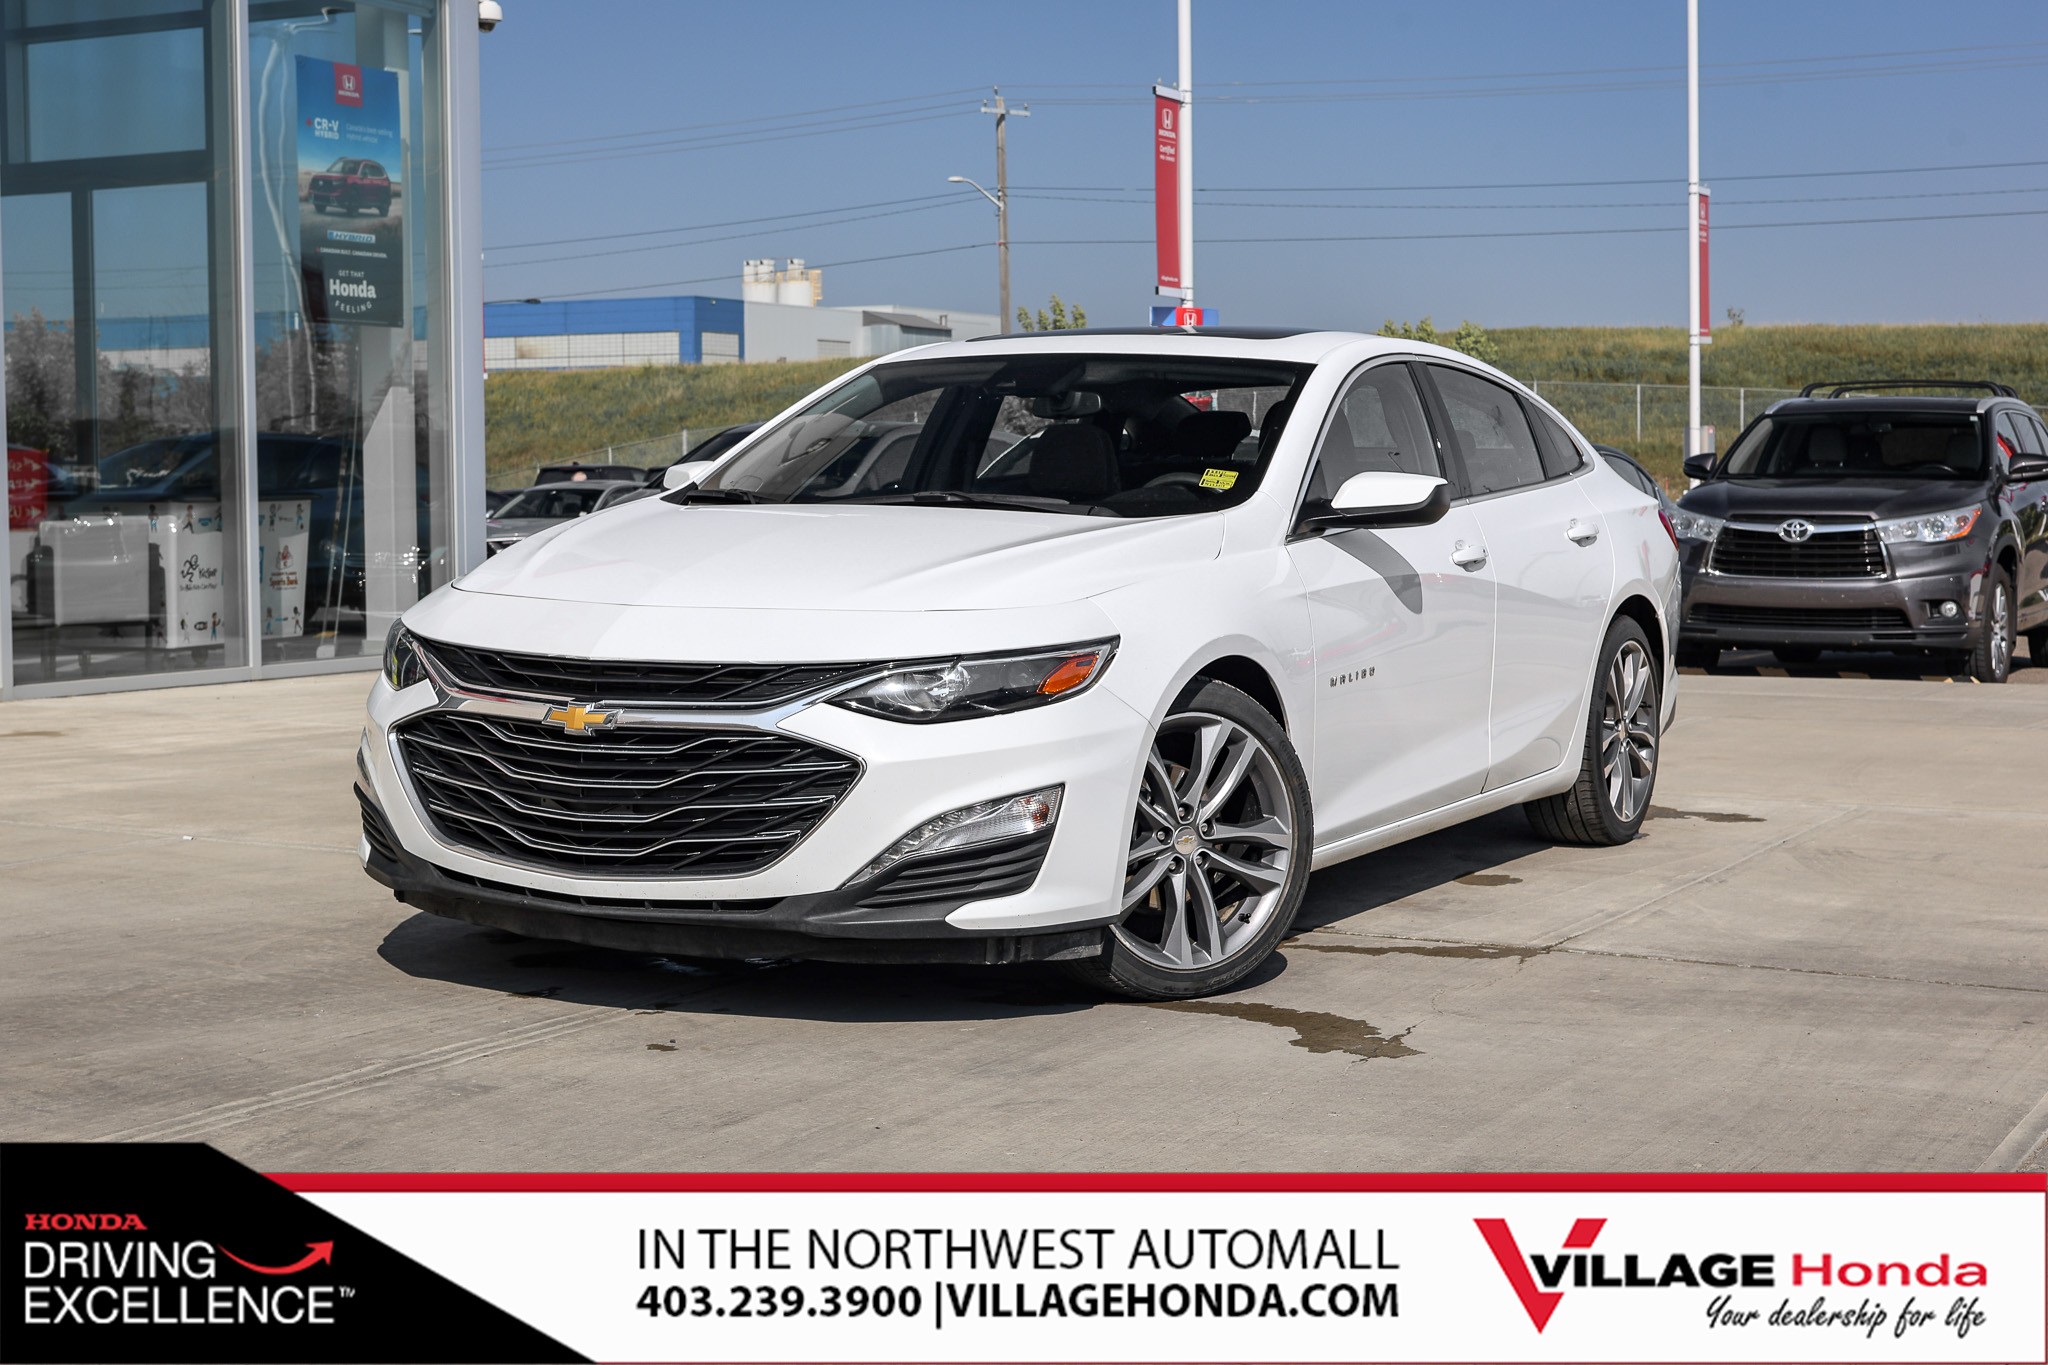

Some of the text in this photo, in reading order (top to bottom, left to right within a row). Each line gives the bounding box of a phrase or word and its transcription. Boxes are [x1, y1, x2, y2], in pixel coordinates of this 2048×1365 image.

[314, 117, 339, 132] CR-V
[314, 130, 340, 140] HYBRID
[350, 270, 365, 278] THAT
[329, 278, 377, 299] Honda
[335, 300, 372, 313] FEELING
[1329, 665, 1376, 688] MALIBU
